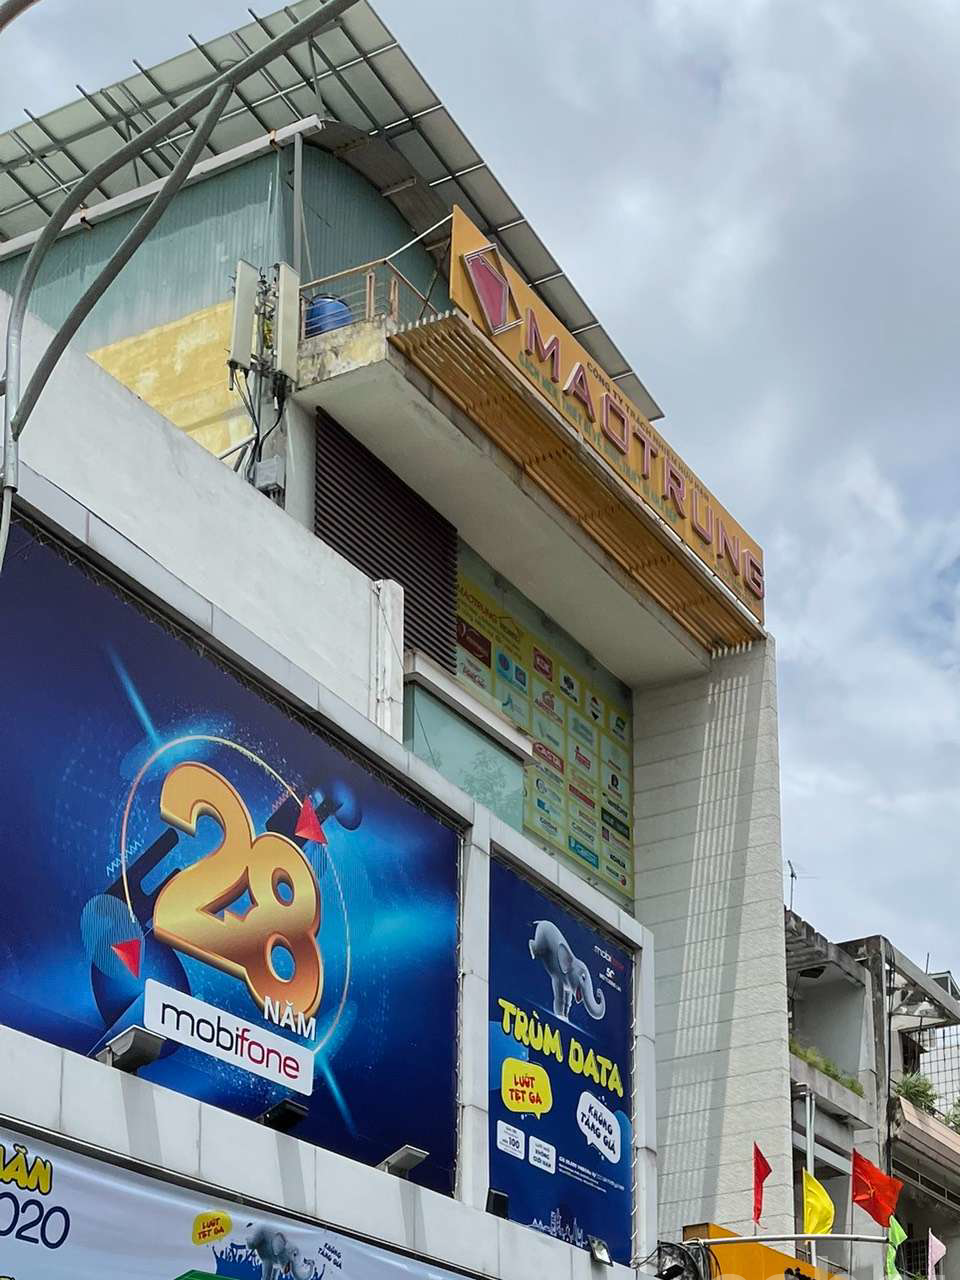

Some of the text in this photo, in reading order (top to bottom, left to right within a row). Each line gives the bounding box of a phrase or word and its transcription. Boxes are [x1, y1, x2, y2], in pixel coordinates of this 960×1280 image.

[523, 307, 765, 601] MAOTRUNG
[153, 761, 324, 1020] 28
[161, 1001, 300, 1080] mobifone
[263, 994, 317, 1041] NĂM
[498, 998, 623, 1098] TRÙM DATA
